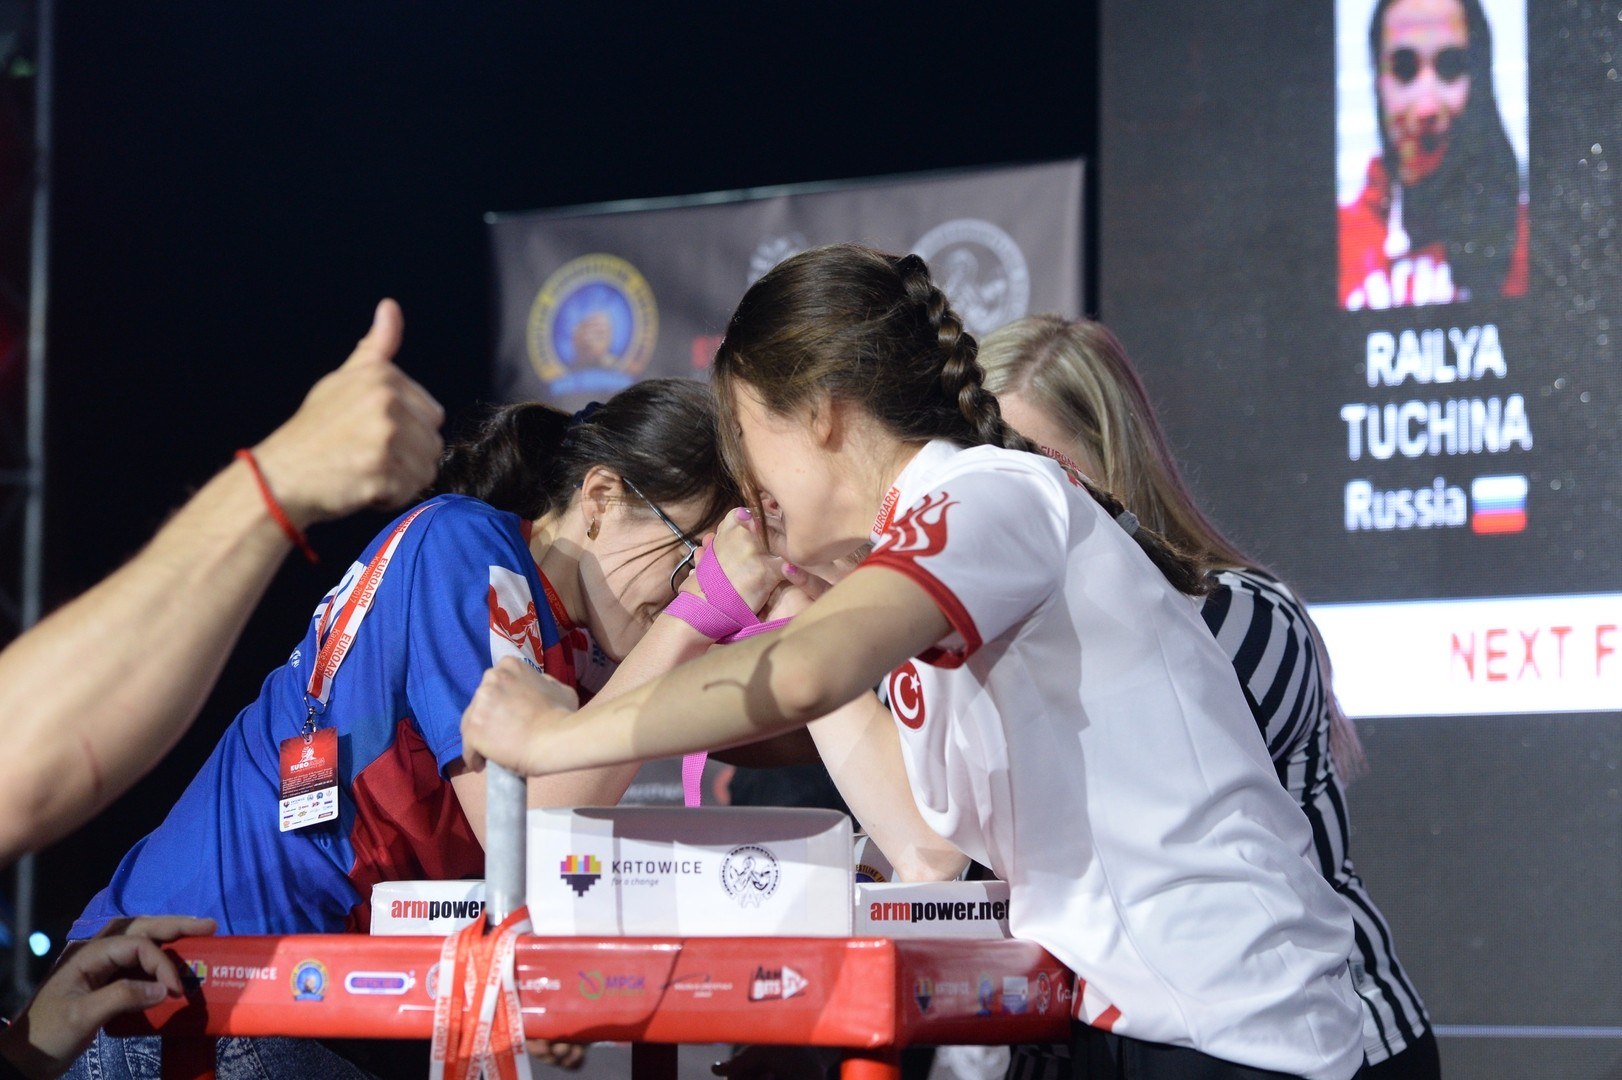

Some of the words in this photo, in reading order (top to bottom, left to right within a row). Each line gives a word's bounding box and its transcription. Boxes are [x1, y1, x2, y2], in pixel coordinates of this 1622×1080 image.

[1366, 324, 1507, 388] RAILYA
[1340, 393, 1533, 461] TUCHINA
[872, 486, 900, 536] EUROARM
[1344, 476, 1467, 532] Russia
[350, 586, 363, 604] 2017
[356, 555, 380, 586] Katowice
[356, 558, 389, 608] EUROARM
[319, 628, 341, 665] Katowice
[1451, 626, 1573, 682] NEXT
[611, 861, 702, 874] KATOWICE
[212, 966, 278, 981] KATOWICE
